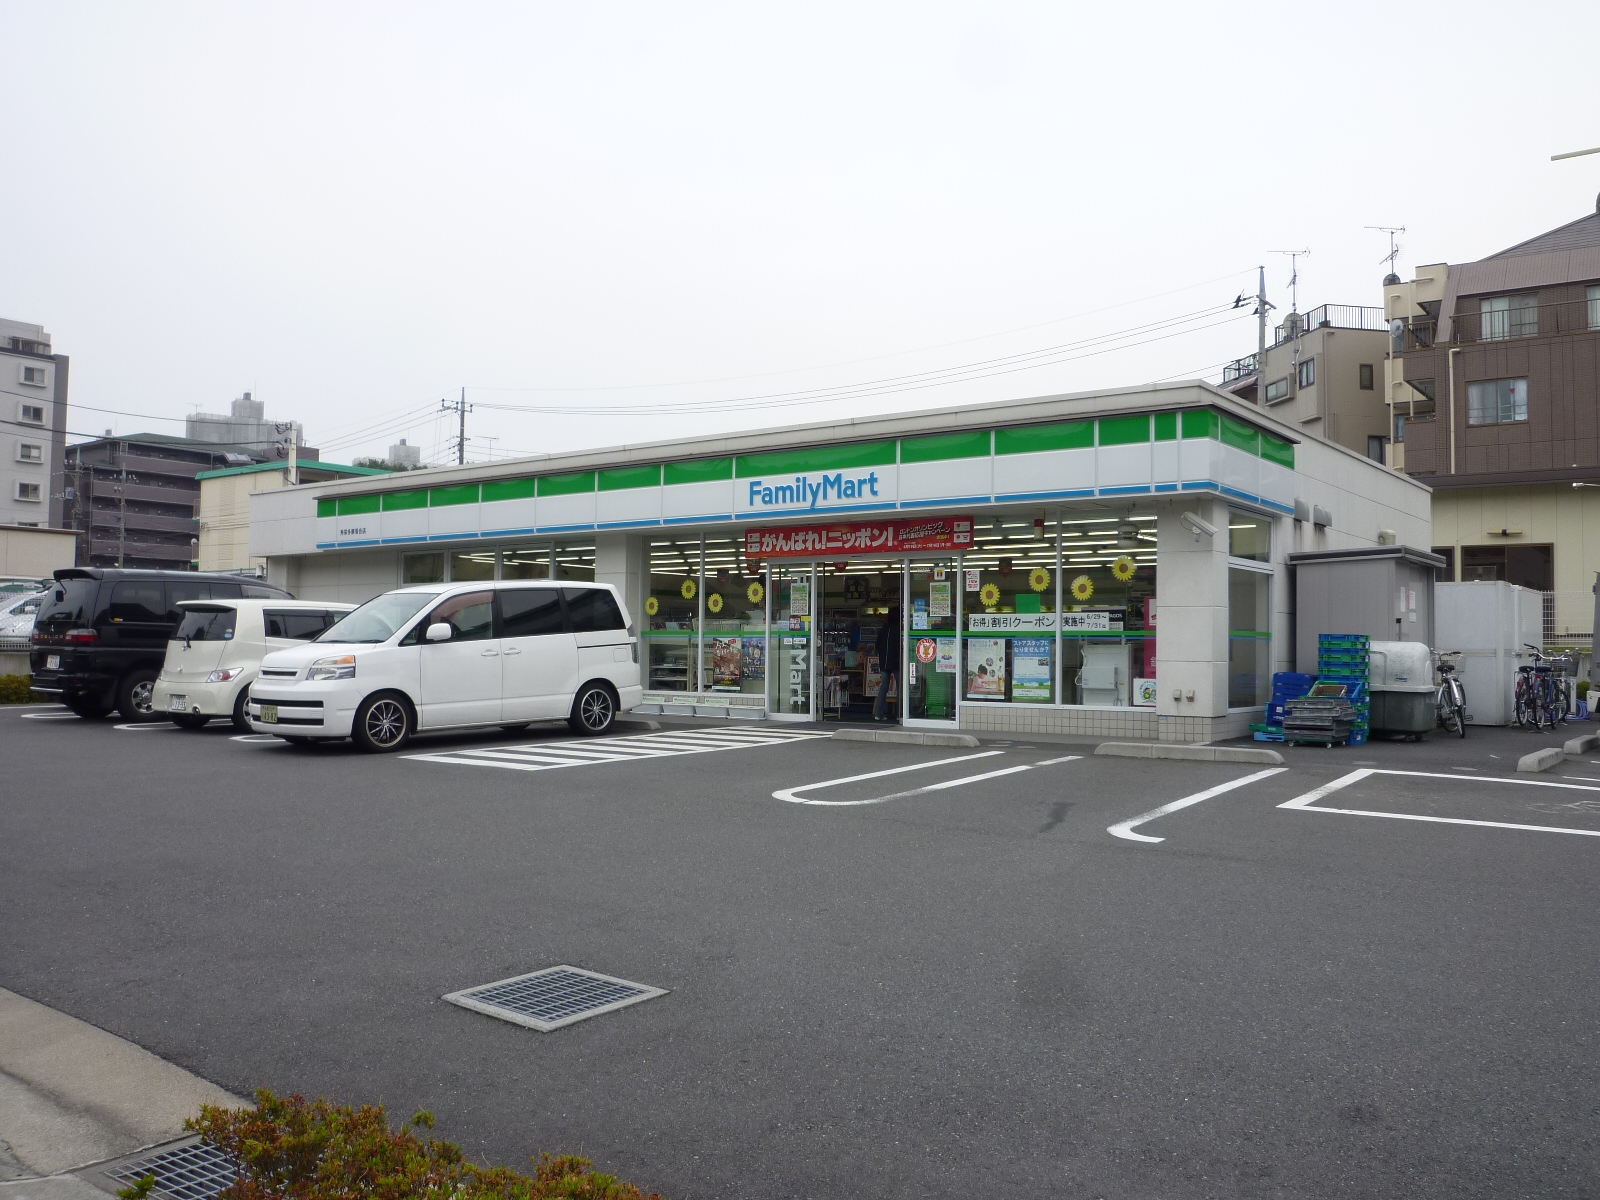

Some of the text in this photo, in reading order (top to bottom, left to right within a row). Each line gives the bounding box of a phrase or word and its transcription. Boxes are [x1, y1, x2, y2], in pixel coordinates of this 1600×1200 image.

[749, 471, 878, 508] FamilyMart
[762, 526, 894, 552] がんばれ!ニッポン!
[1062, 616, 1086, 628] 実施中
